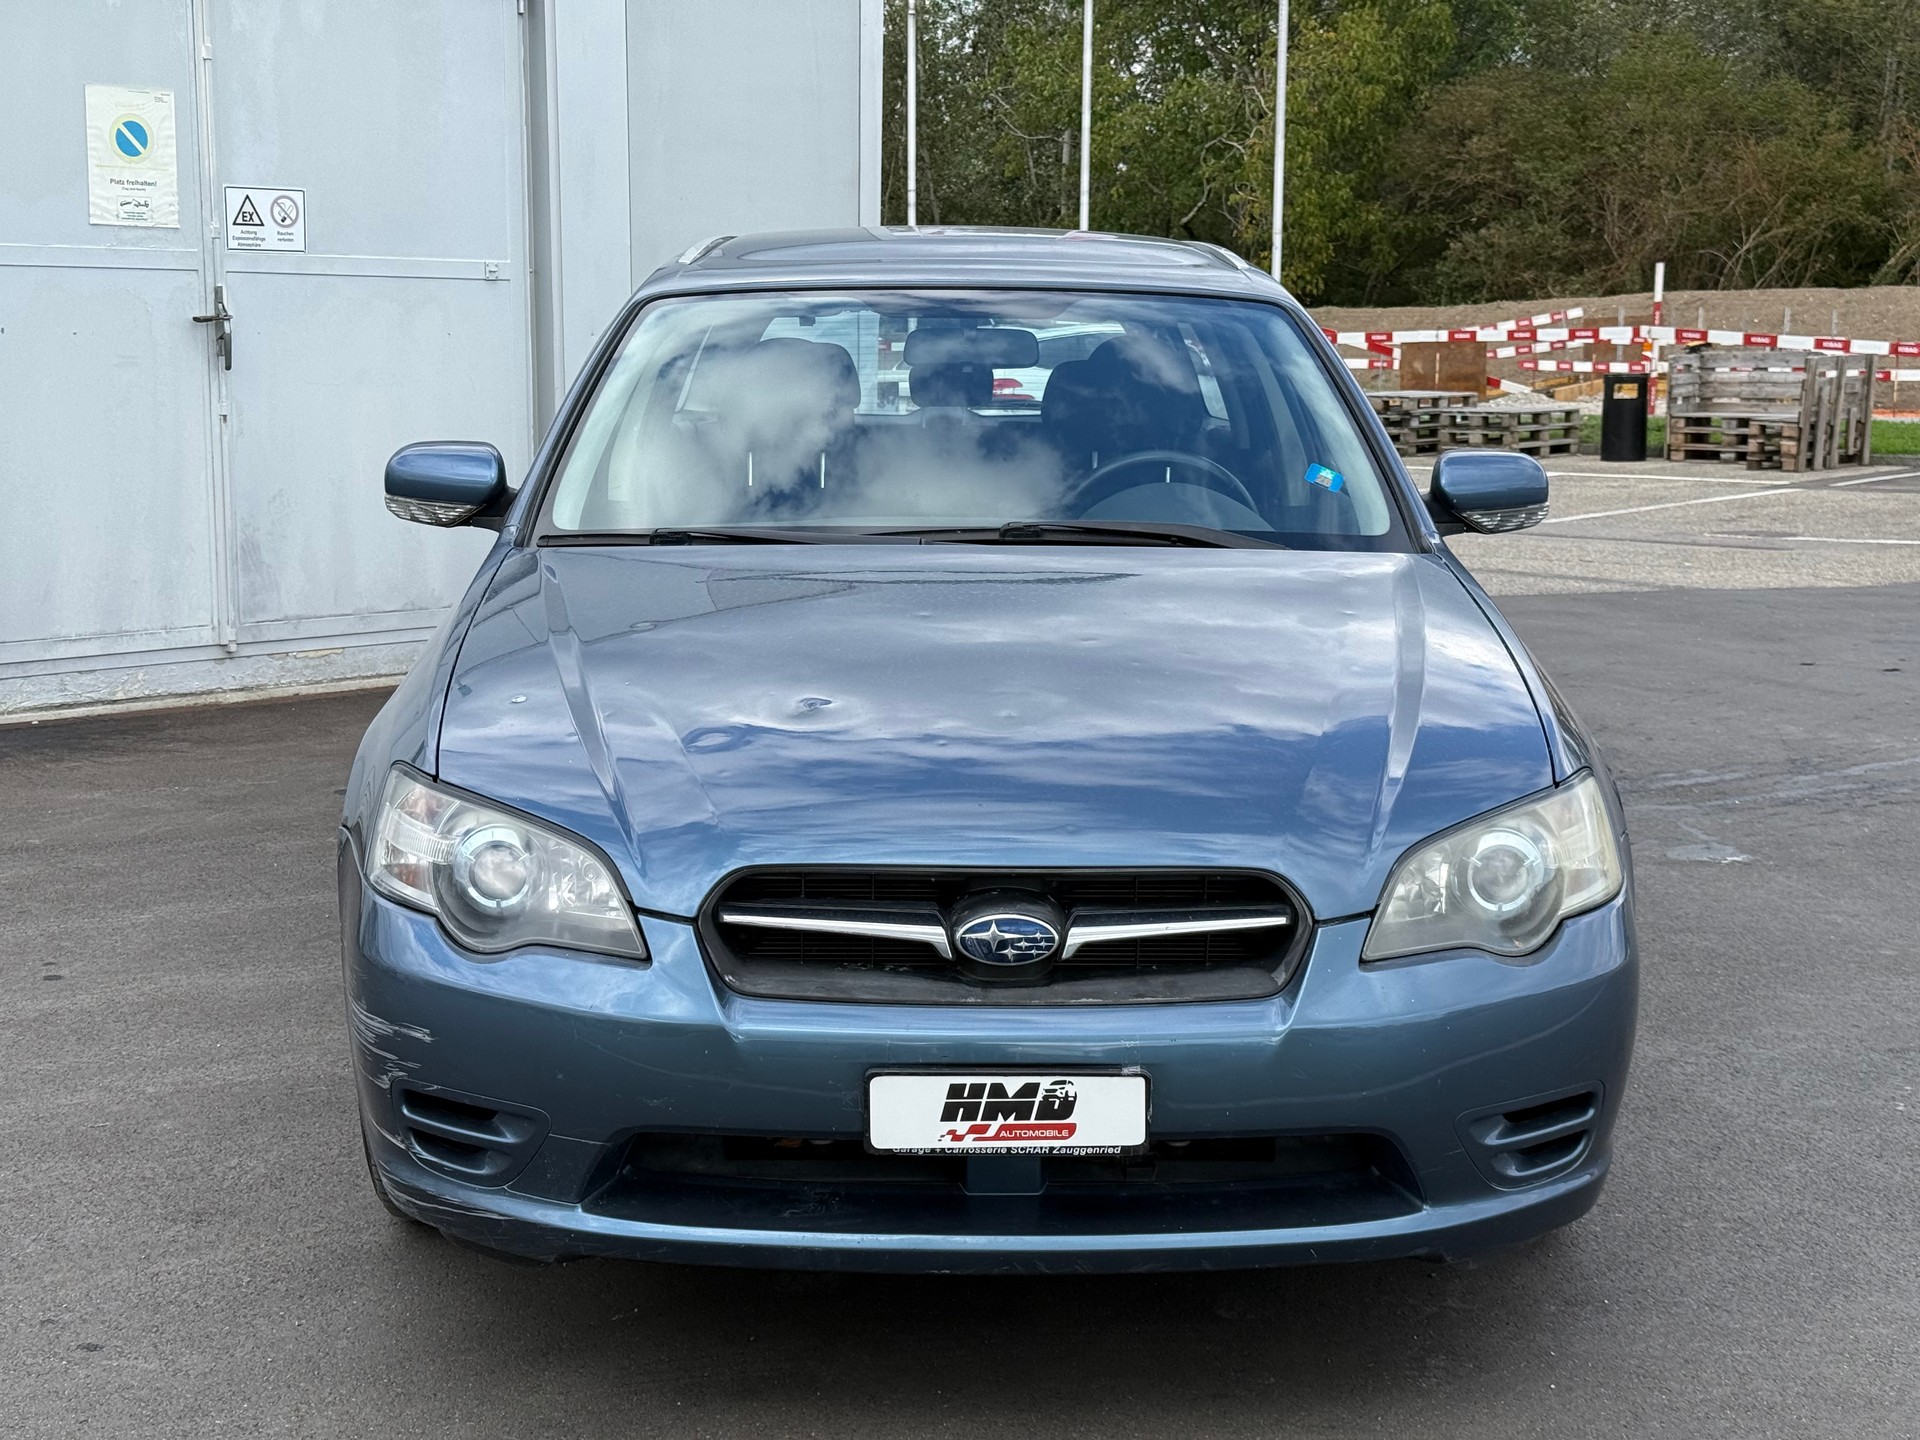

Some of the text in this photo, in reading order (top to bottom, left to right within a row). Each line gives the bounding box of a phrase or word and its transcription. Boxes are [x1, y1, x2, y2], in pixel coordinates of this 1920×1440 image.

[109, 178, 158, 187] Platz freihalten!
[241, 211, 255, 223] EX
[999, 1129, 1069, 1138] AUTOMOBILE
[892, 1147, 932, 1155] Garage
[944, 1146, 1008, 1154] Carrosserie
[1052, 1145, 1122, 1156] Zauggenried
